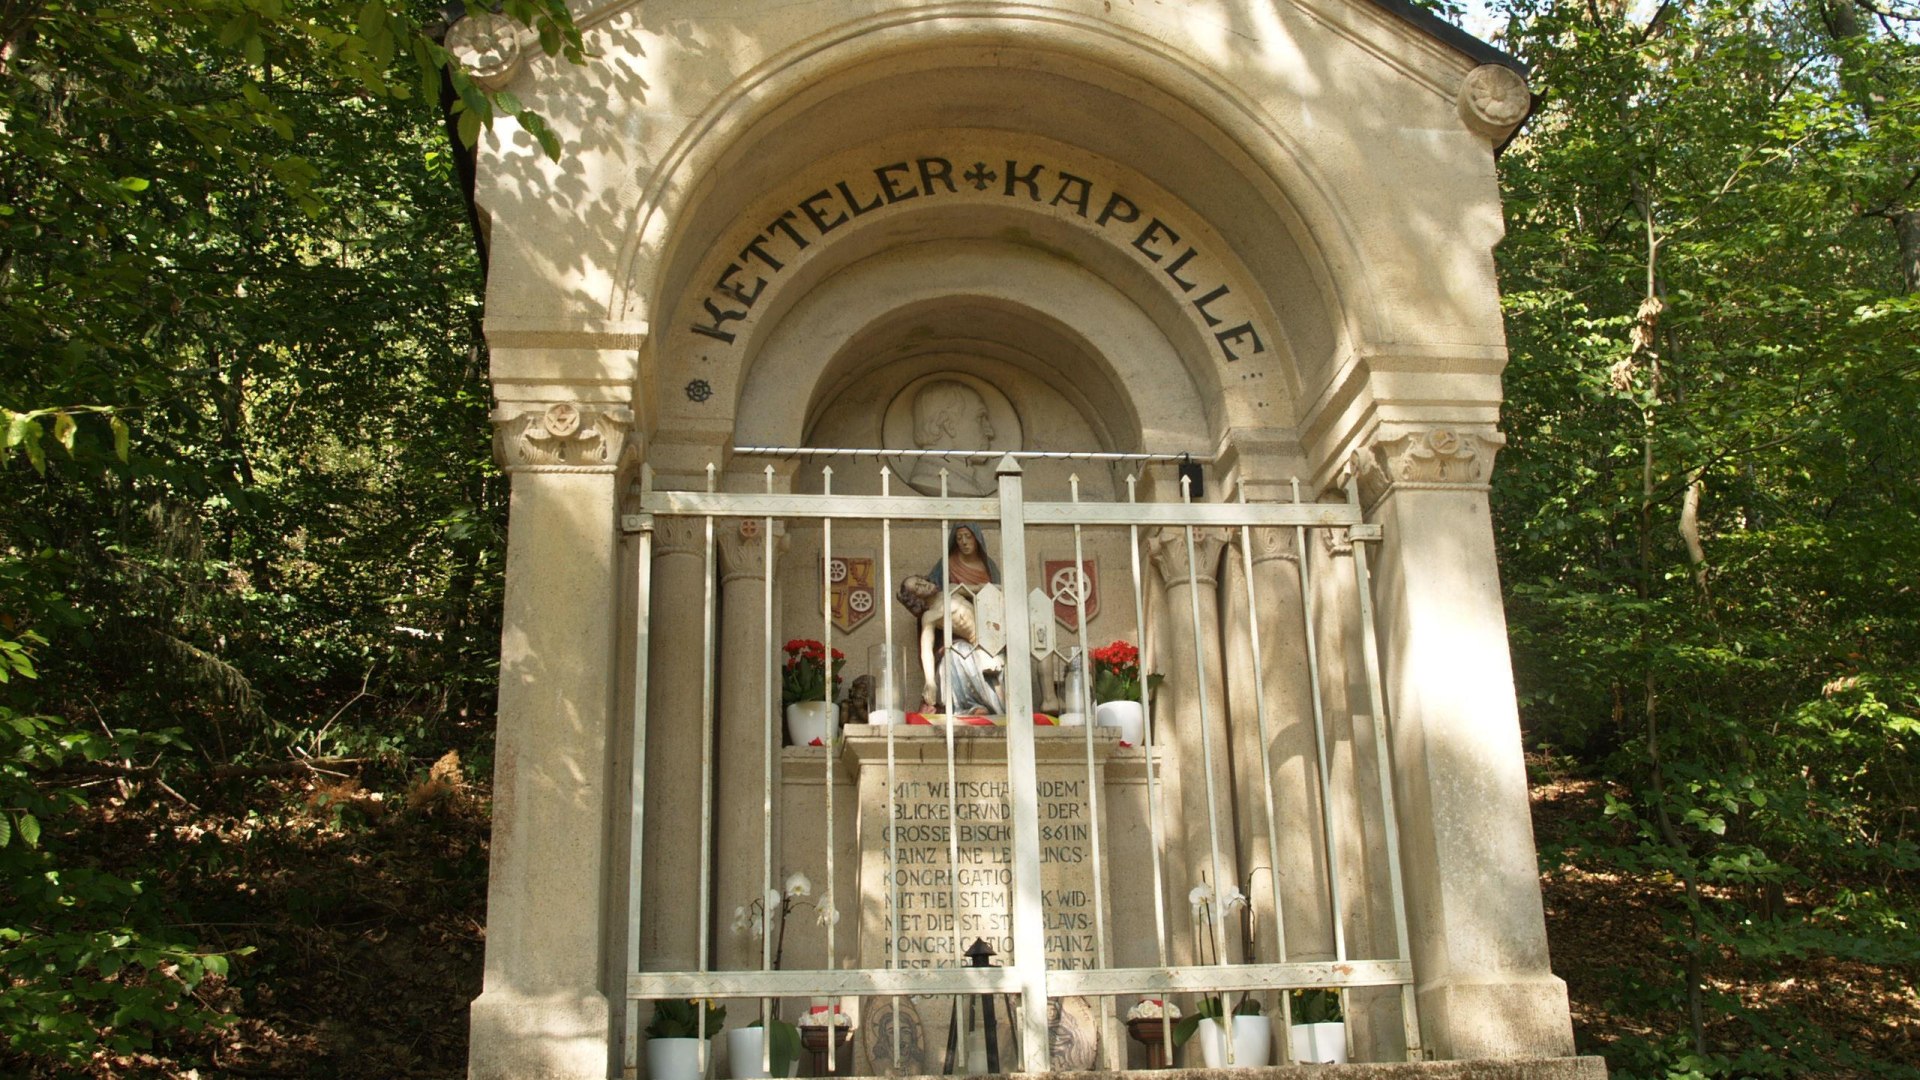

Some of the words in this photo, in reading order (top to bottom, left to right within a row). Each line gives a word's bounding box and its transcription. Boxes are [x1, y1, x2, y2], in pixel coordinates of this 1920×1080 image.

[691, 157, 958, 345] KETTELER
[1003, 160, 1264, 362] KAPELLE
[894, 803, 949, 820] BLICKE
[1048, 803, 1080, 819] DER
[882, 825, 951, 843] GROSSE
[1072, 825, 1088, 841] IN
[1057, 890, 1092, 907] WID-
[926, 914, 954, 931] DIE
